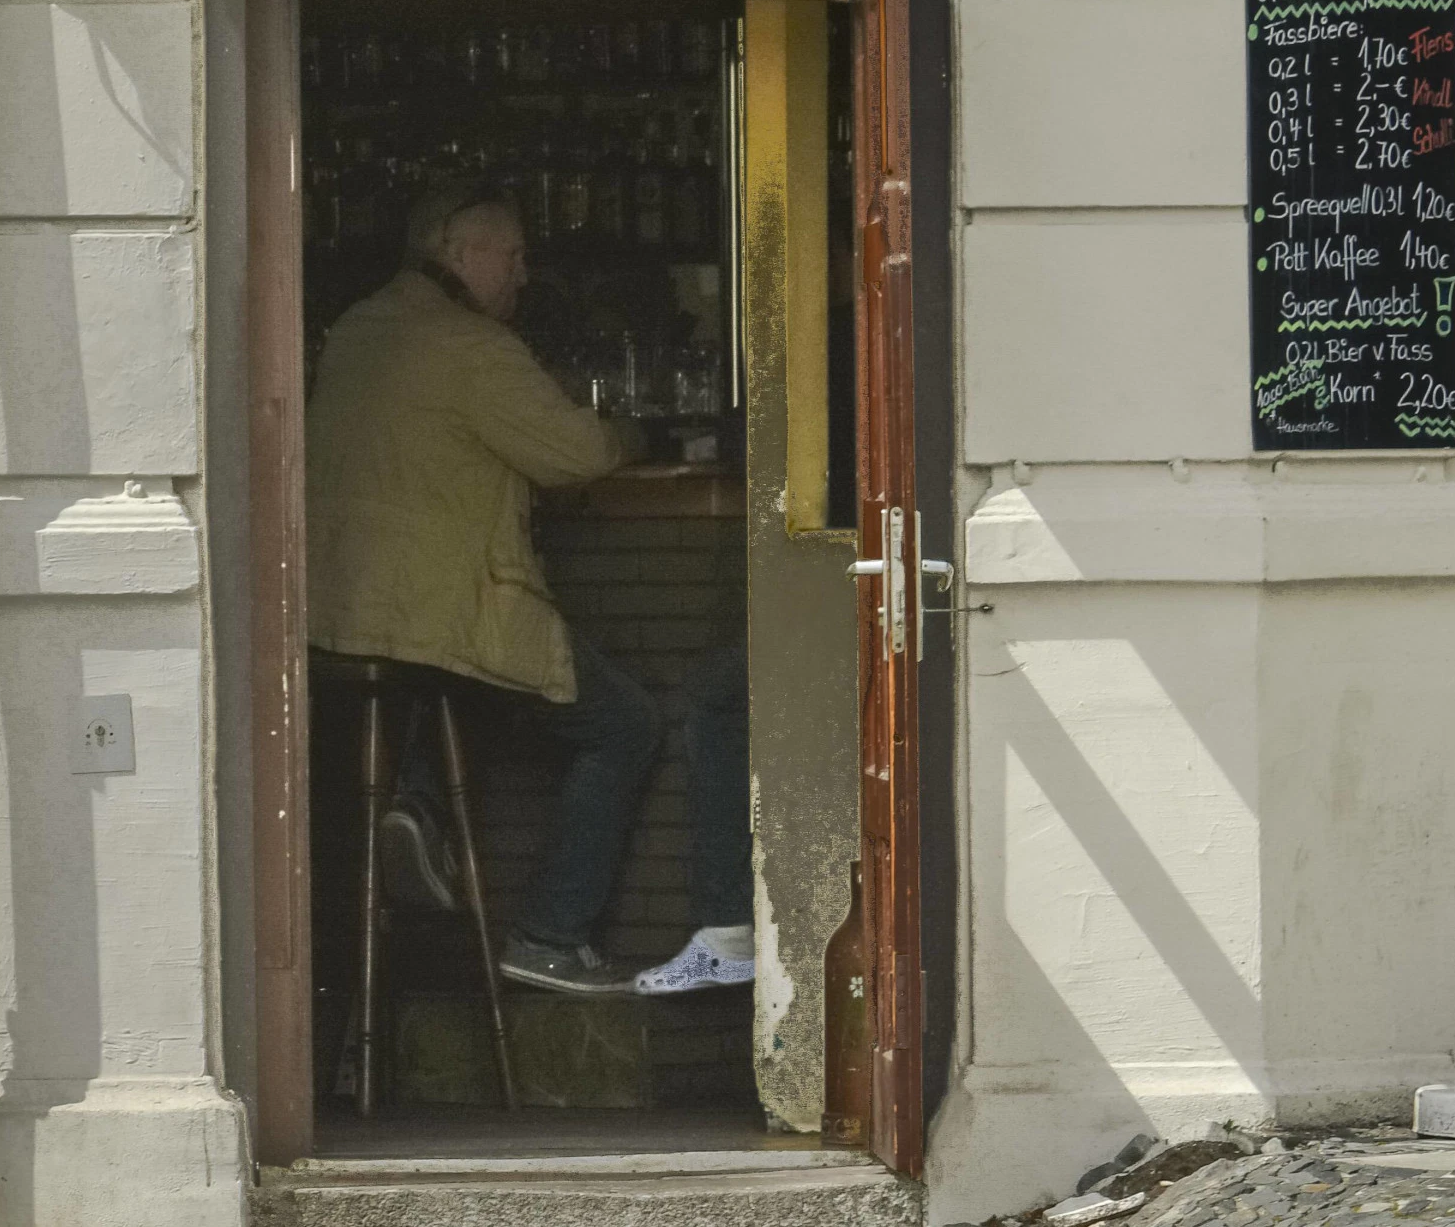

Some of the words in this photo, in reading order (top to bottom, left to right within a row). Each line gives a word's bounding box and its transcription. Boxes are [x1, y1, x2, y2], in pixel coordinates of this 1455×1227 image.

[1263, 15, 1364, 45] Fassbiere:
[1408, 26, 1455, 63] Flens
[1412, 77, 1453, 108] Kindl
[1267, 183, 1371, 238] Spreequell
[1265, 241, 1309, 271] Pott
[1314, 234, 1380, 281] Kaffee
[1280, 290, 1340, 324] Super
[1344, 283, 1421, 323] Angebot
[1325, 338, 1368, 363] Bier
[1386, 334, 1434, 361] Fass
